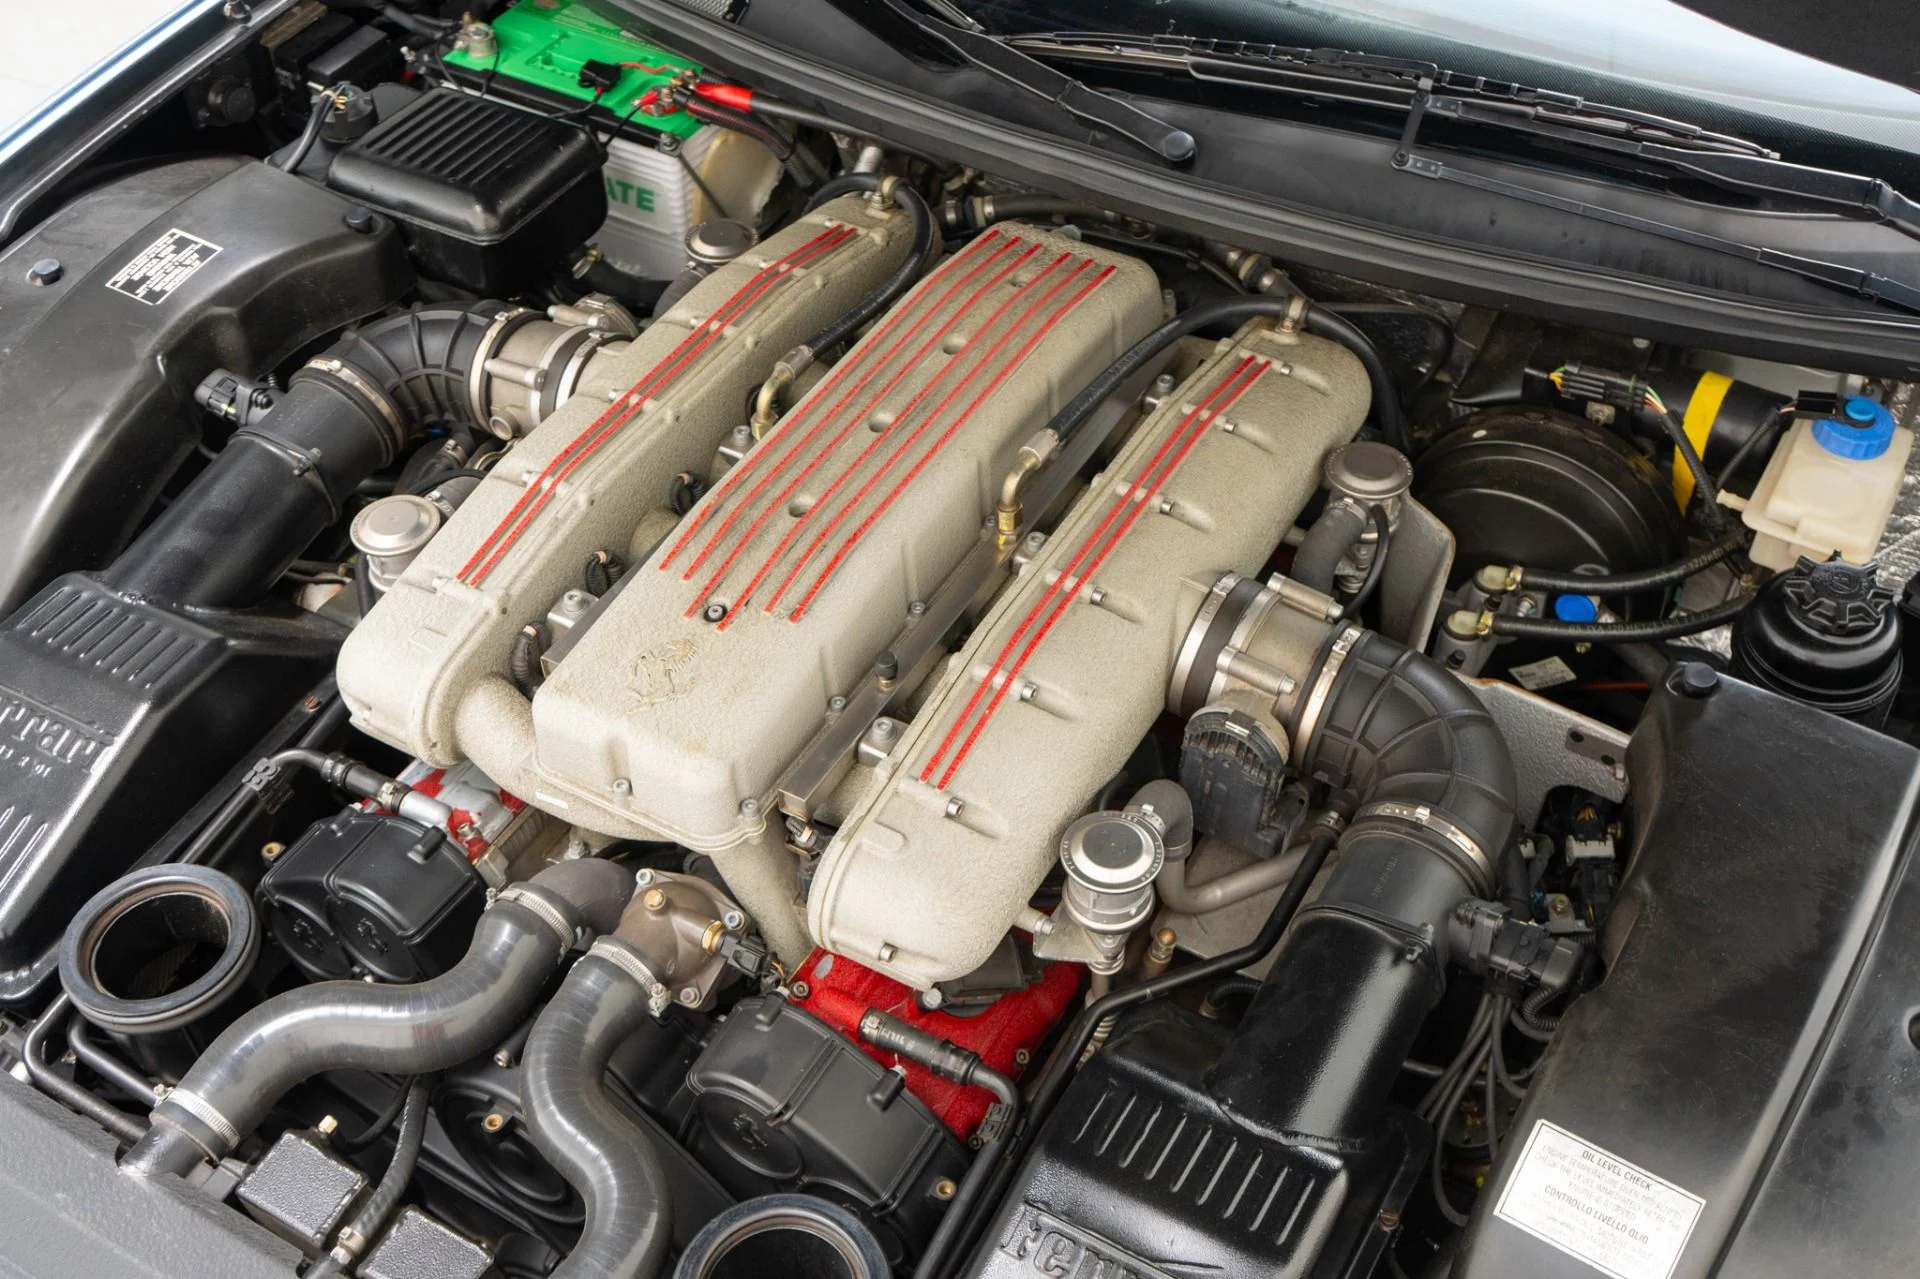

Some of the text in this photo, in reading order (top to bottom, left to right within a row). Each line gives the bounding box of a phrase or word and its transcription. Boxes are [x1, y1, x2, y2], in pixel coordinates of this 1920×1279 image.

[1581, 1150, 1653, 1192] OIL LEVEL CHECK
[1543, 1185, 1593, 1216] CONTROLLO
[1593, 1210, 1628, 1233] LIVELLO
[1627, 1227, 1650, 1245] OLIO
